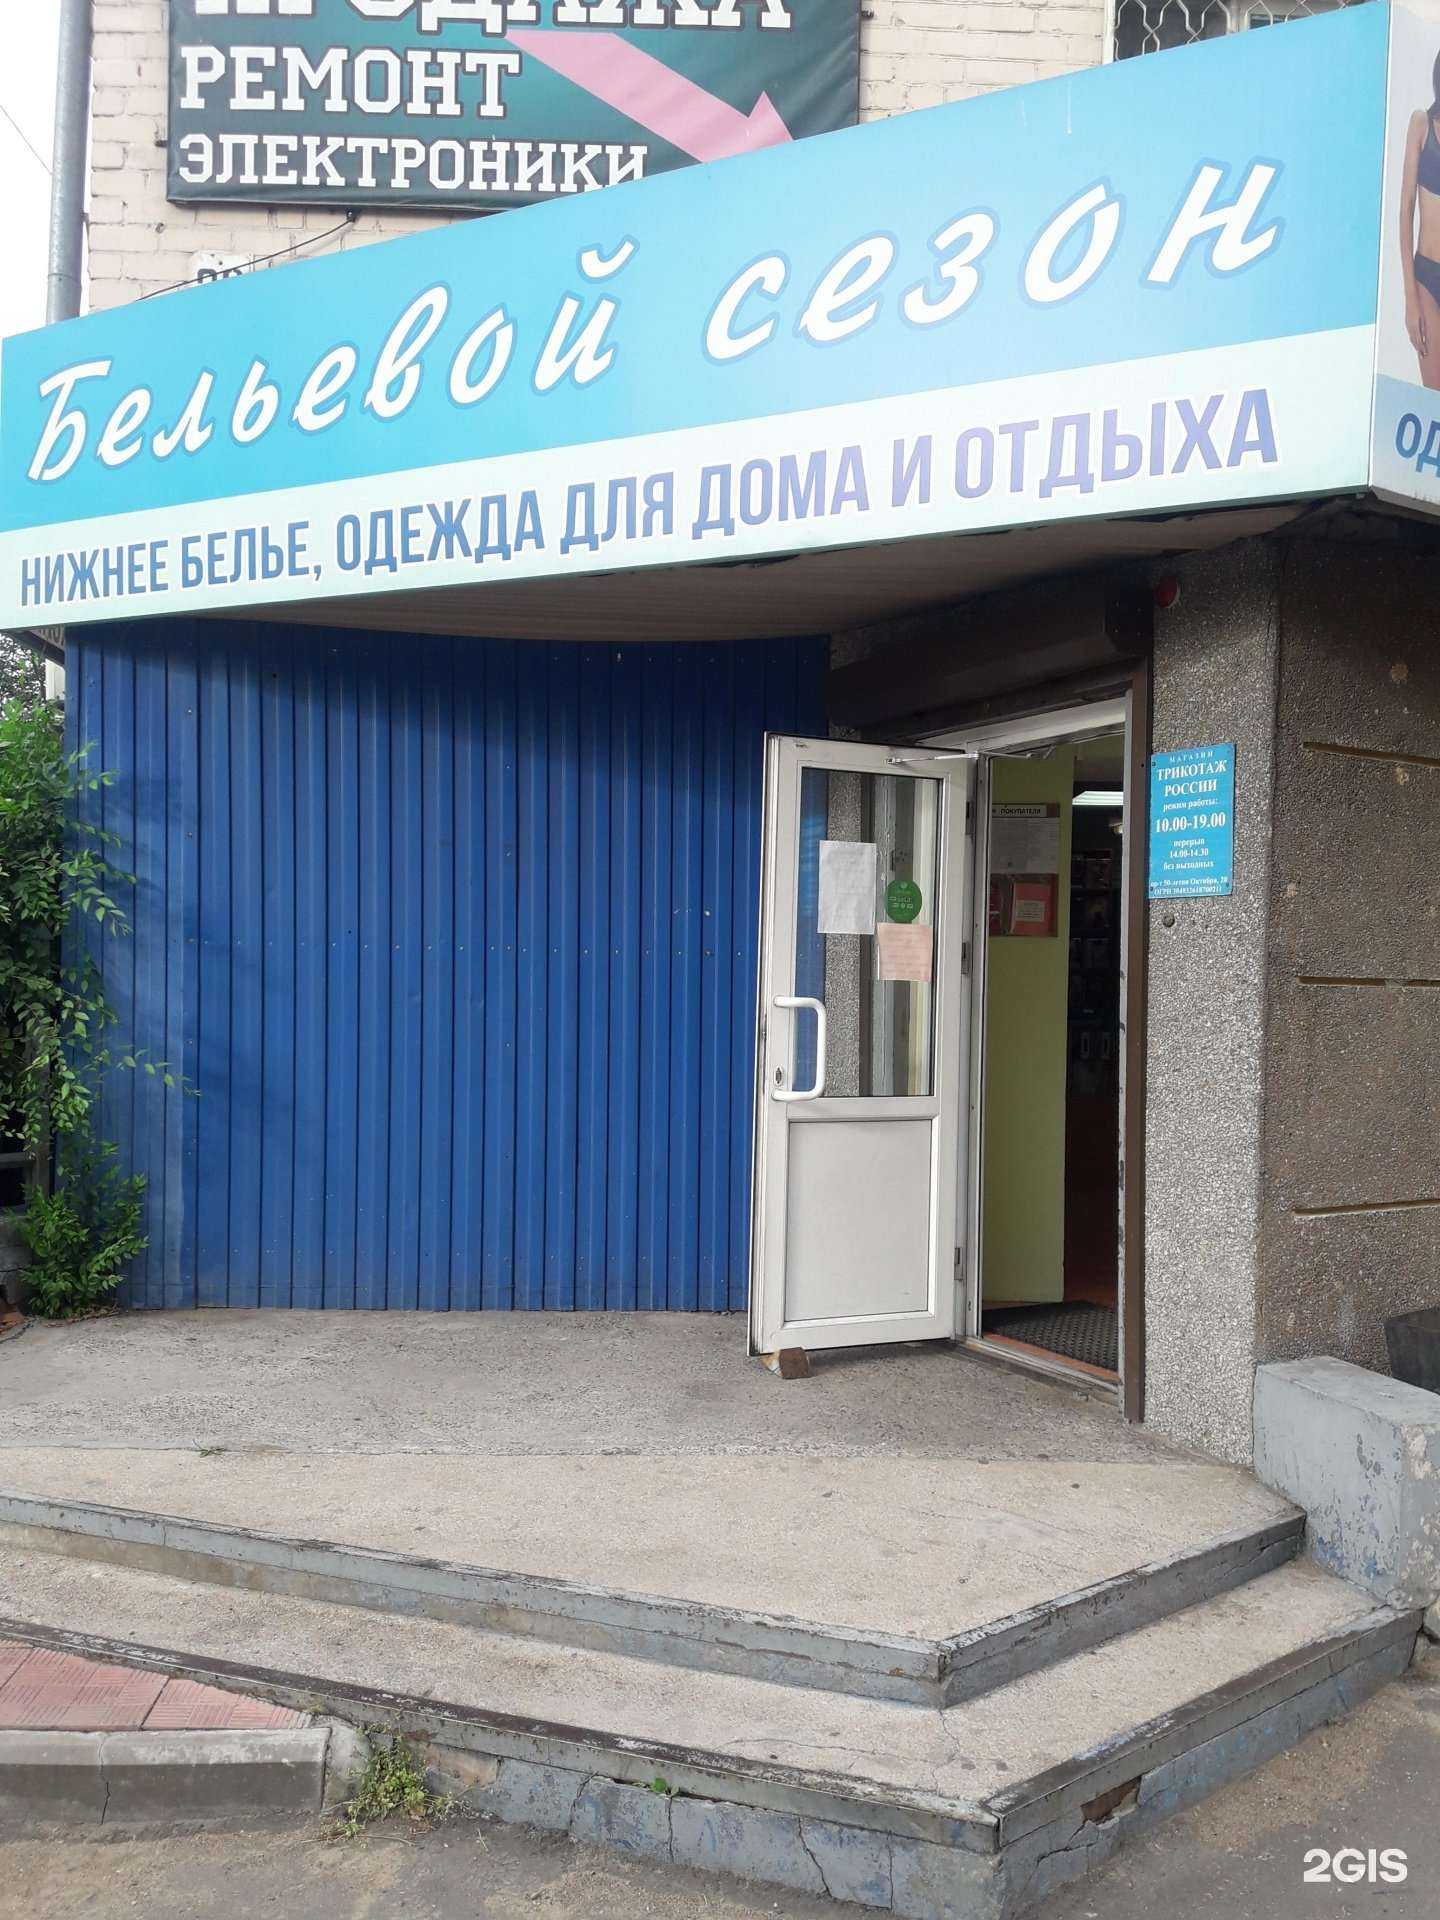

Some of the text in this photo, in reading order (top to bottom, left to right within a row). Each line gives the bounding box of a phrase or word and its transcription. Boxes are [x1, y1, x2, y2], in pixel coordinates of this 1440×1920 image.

[180, 45, 520, 117] РЕМОНТ
[178, 133, 648, 193] ЭЛЕКТРОНИКИ
[26, 163, 1278, 482] Бельевой сезон
[20, 387, 1280, 607] НИЖНЕЕ БЕЛЬЕ, ОДЕЖДА ДЛЯ ДОМА И ОТДЫХА
[1157, 760, 1228, 781] ТРИКОТАЖ
[1164, 779, 1218, 797] РОССИИ
[1155, 812, 1227, 833] 10.00-19.00
[1162, 802, 1187, 813] режим
